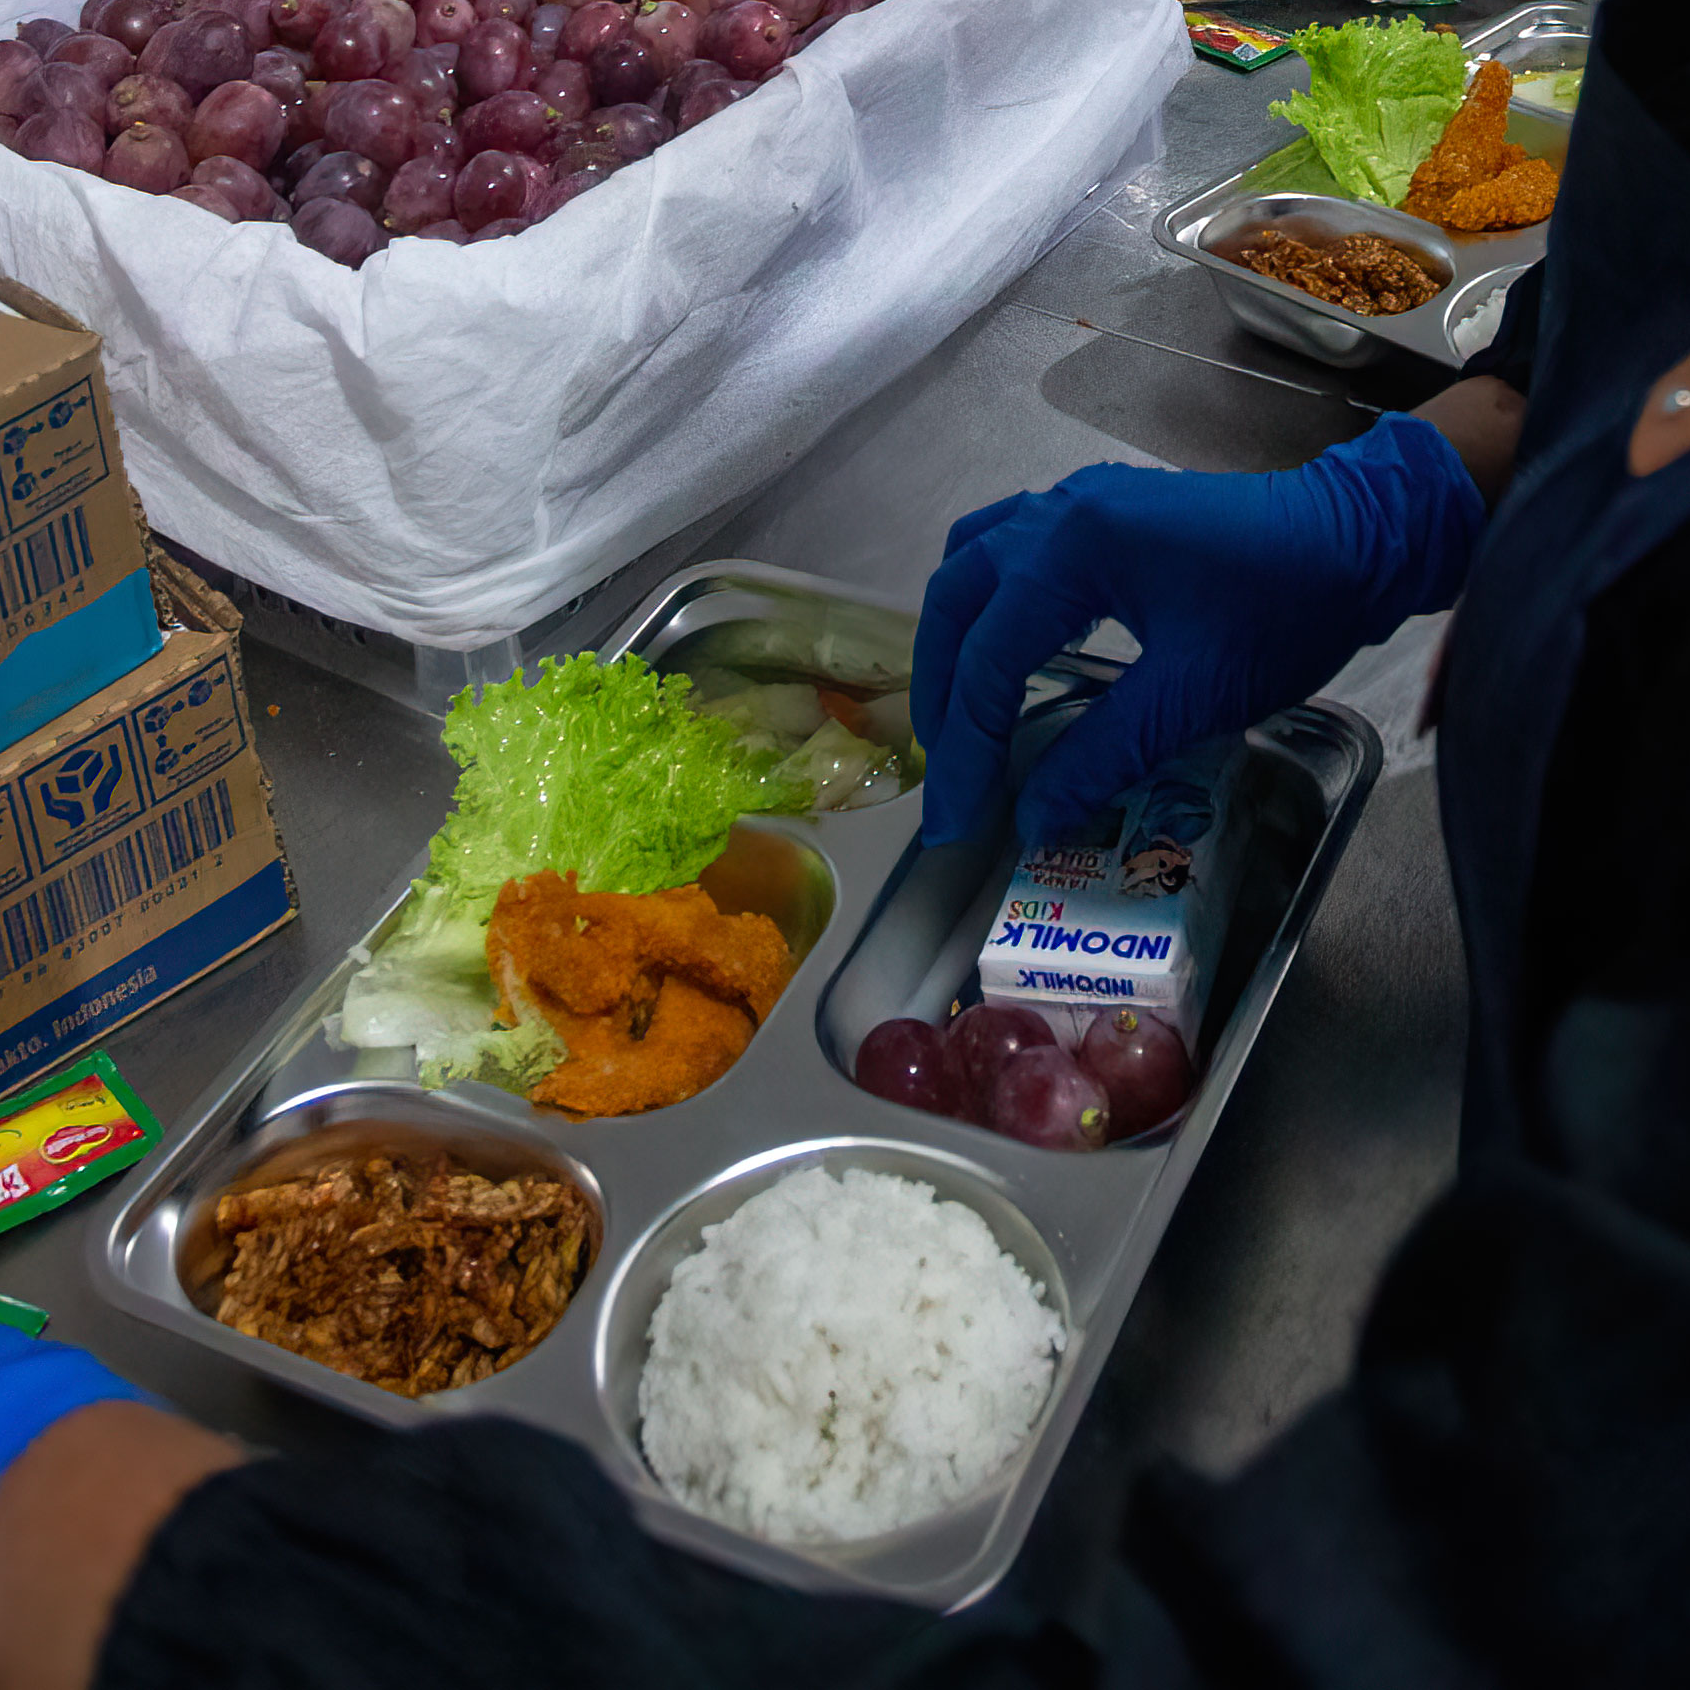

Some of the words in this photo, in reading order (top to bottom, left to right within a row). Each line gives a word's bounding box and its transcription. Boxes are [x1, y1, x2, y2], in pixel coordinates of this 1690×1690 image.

[1008, 900, 1064, 922] KIDS
[995, 921, 1172, 960] INDOMILK
[1018, 969, 1135, 997] INDOMILK
[52, 962, 160, 1043] Indonesia
